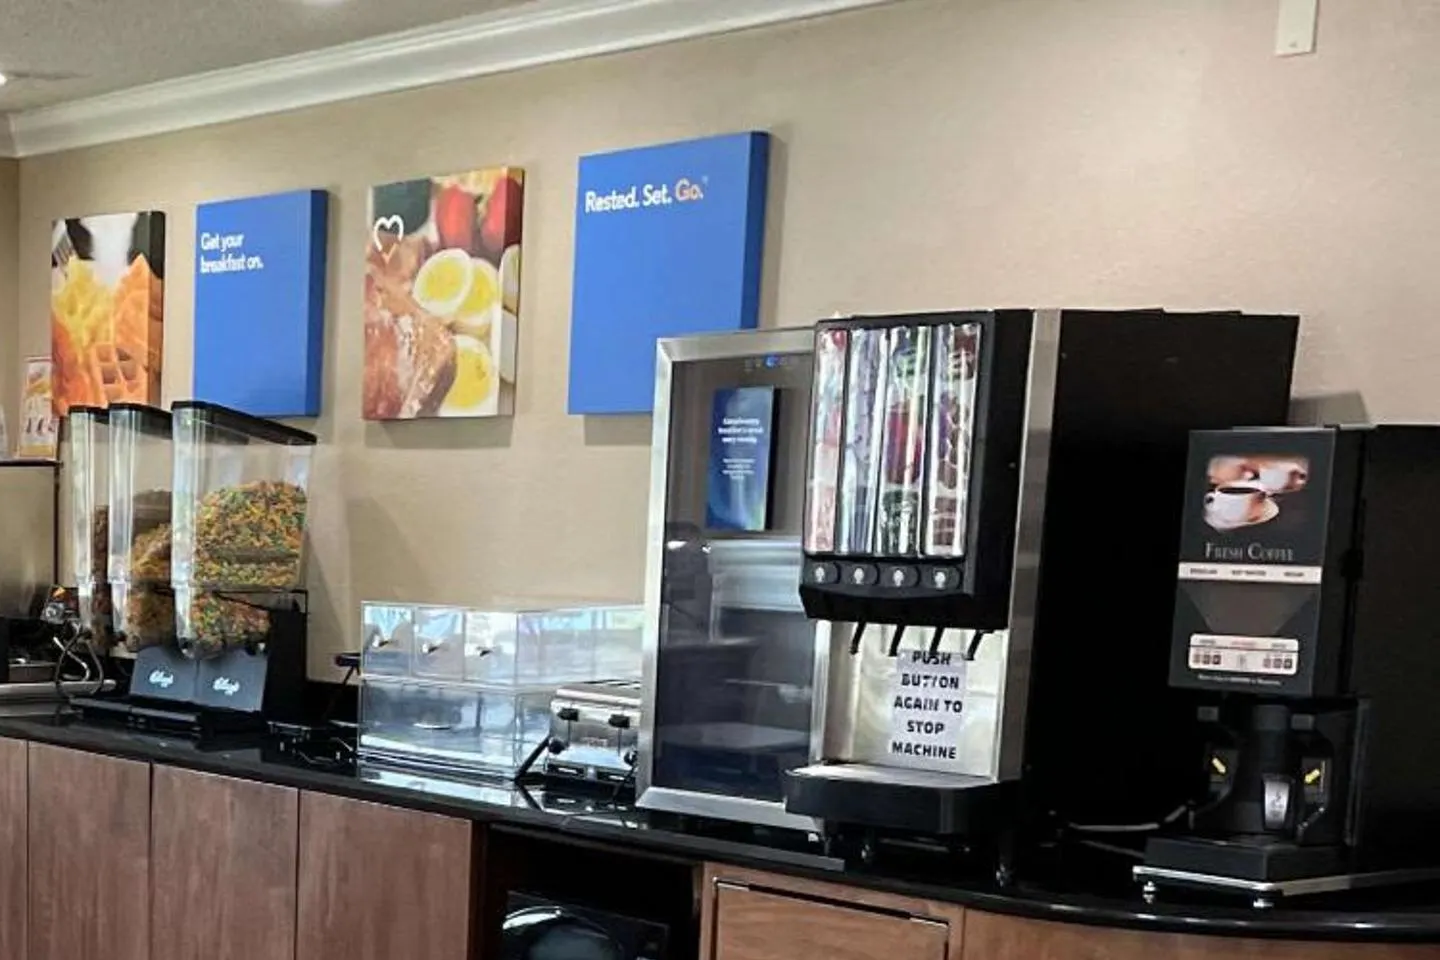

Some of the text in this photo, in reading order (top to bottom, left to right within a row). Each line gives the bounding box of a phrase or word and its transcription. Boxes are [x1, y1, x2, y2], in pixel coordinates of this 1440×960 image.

[585, 186, 640, 213] Rested.
[642, 184, 672, 206] Set.
[201, 231, 244, 252] Get your
[912, 650, 952, 666] PUSH
[901, 673, 960, 690] BUTTON
[893, 695, 963, 713] AGAIN TO
[906, 719, 945, 735] STOP
[891, 741, 957, 760] MACHINE
